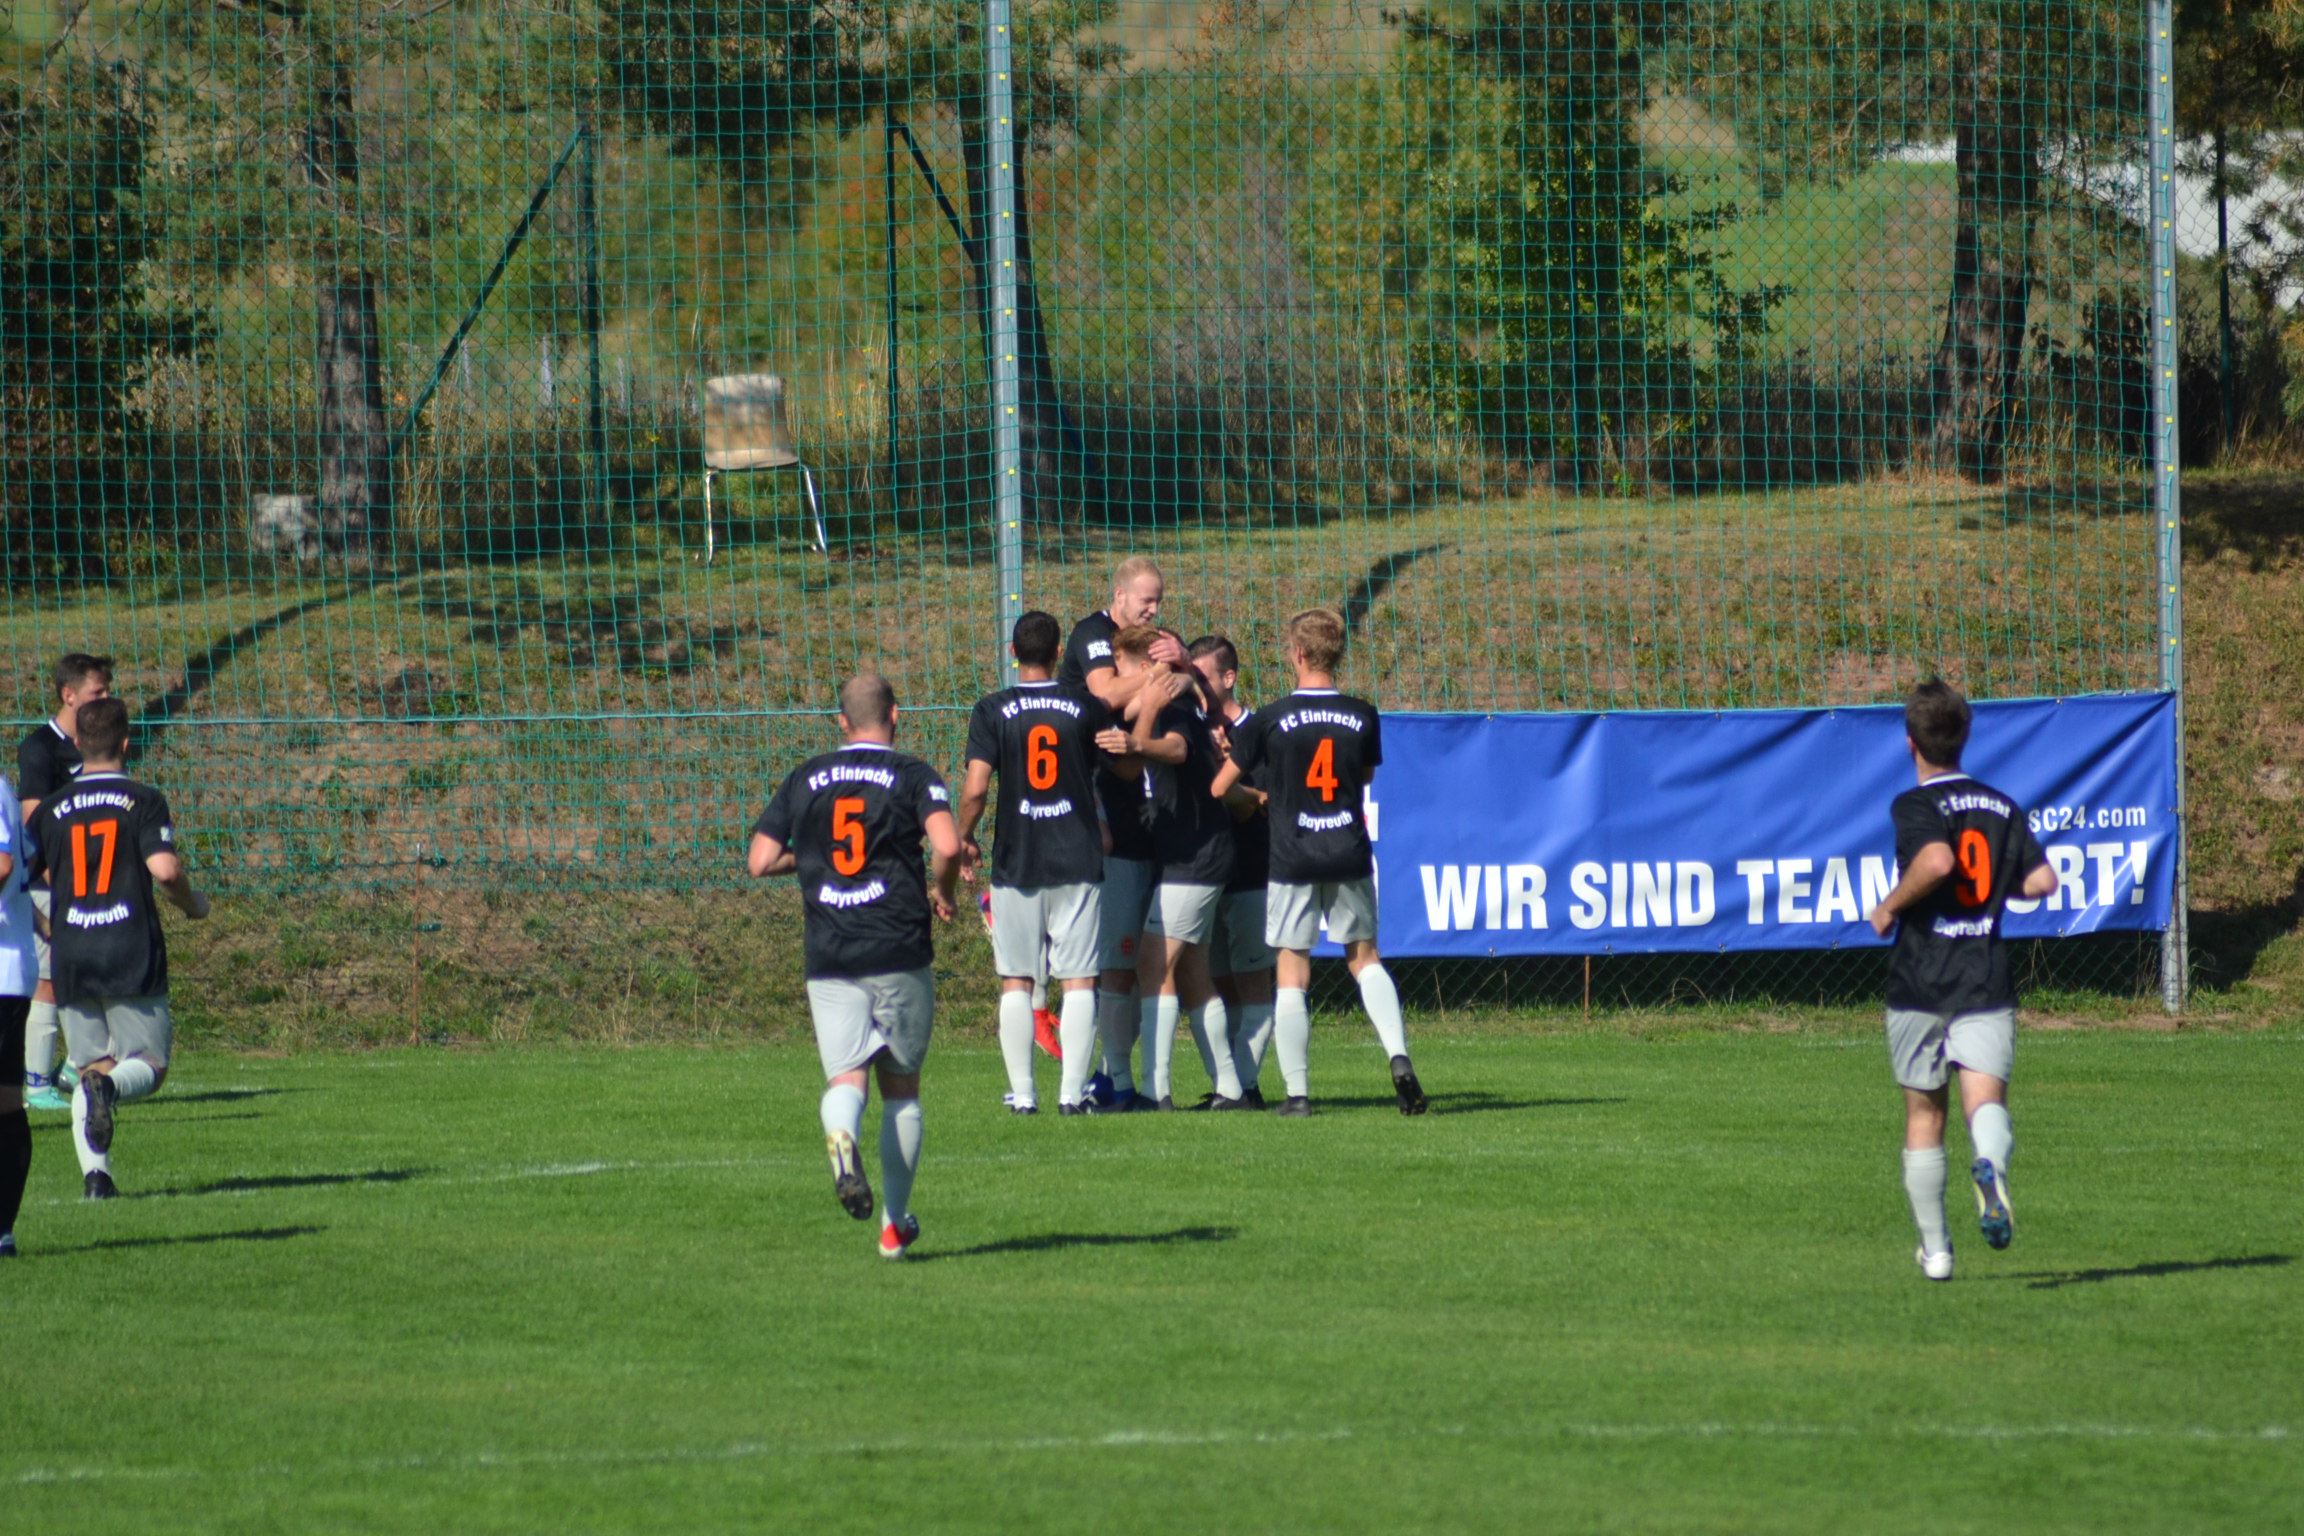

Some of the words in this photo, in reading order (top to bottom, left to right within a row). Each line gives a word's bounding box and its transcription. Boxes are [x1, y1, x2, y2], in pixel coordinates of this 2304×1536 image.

[1002, 702, 1019, 719] FC
[1020, 697, 1081, 718] Eintracht
[1280, 714, 1298, 732] FC
[1300, 709, 1362, 732] Eintracht
[1028, 724, 1058, 790] 6
[1306, 738, 1338, 802] 4
[808, 771, 829, 791] FC
[831, 766, 895, 788] Eintracht
[53, 801, 72, 820] FC
[73, 792, 135, 812] Eintracht
[1950, 794, 2011, 819] Entracht
[1298, 811, 1353, 832] Bayreuth
[832, 797, 865, 876] 5
[71, 819, 118, 897] 17
[1956, 829, 1991, 907] 9
[819, 879, 885, 909] Bayreuth
[1420, 864, 1548, 931] WIR
[1569, 861, 1716, 930] SIND
[66, 904, 129, 929] Bayreuth
